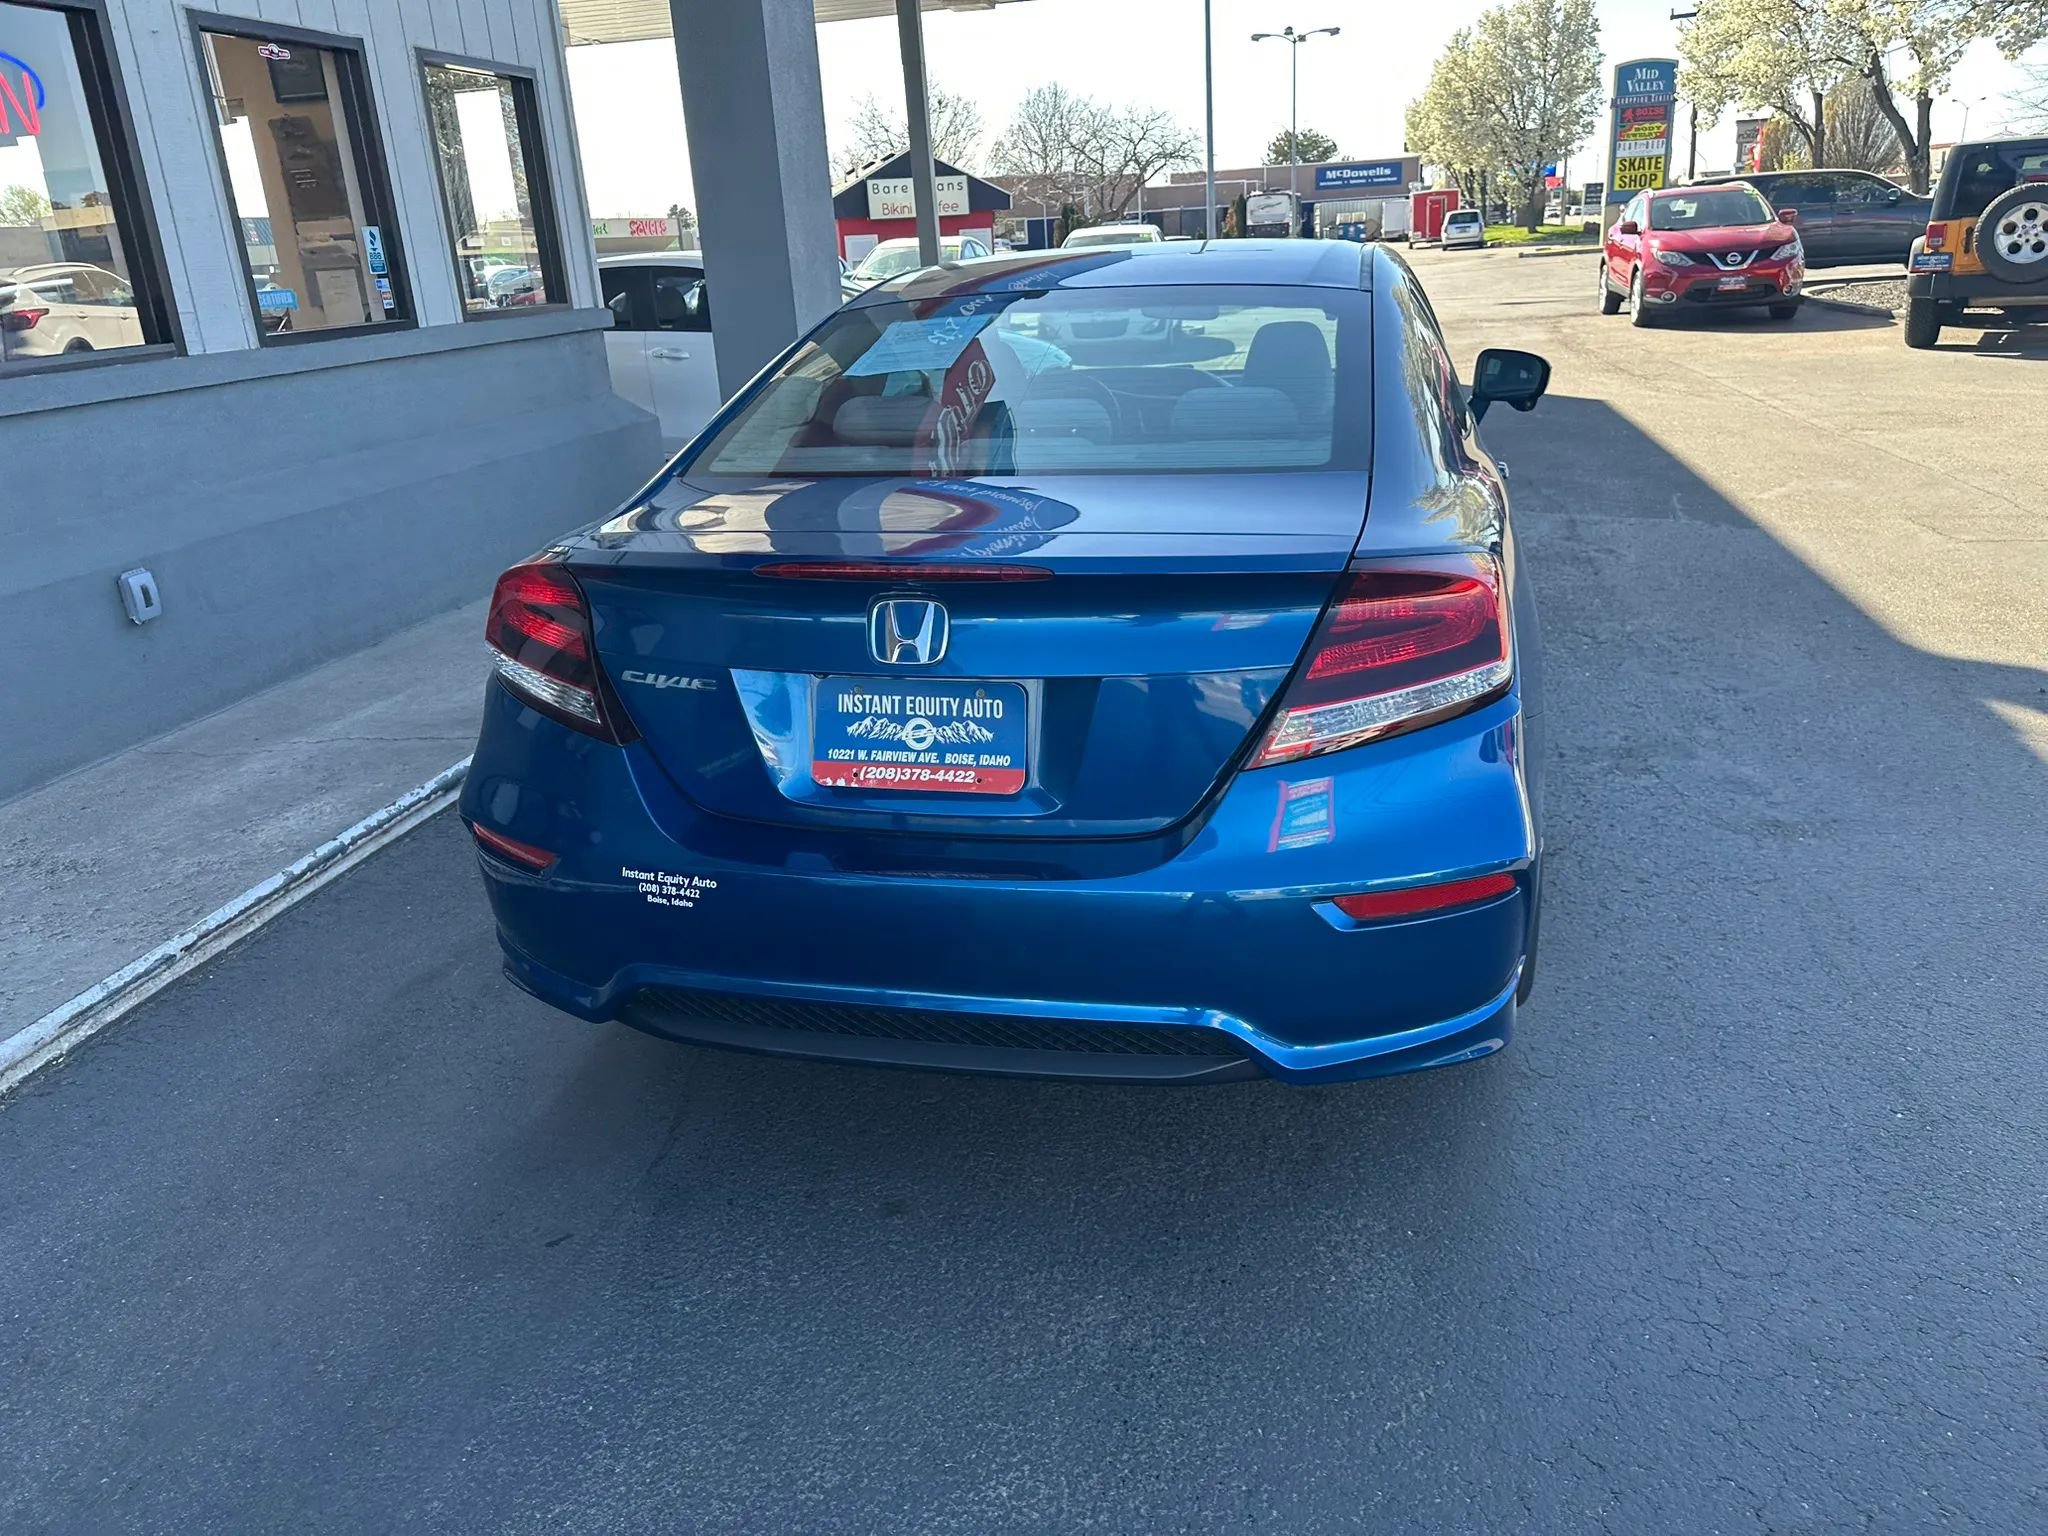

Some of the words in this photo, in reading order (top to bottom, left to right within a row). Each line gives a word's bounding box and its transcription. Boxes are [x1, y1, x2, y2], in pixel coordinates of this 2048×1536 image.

[1618, 156, 1663, 172] SKATE
[1325, 166, 1392, 179] McDowells
[871, 182, 909, 195] Bare
[1618, 173, 1658, 189] SHOP
[882, 201, 913, 216] Bikini
[838, 693, 901, 715] INSTANT
[906, 695, 960, 718] EQUITY
[963, 698, 1004, 719] AUTO
[827, 748, 855, 760] 10221
[857, 750, 869, 760] W.
[870, 750, 917, 763] FAIRVIEW
[918, 752, 940, 764] AVE.
[944, 754, 977, 767] BOISE,
[979, 755, 1011, 766] IDAHO
[859, 766, 976, 783] (208)378-4422
[621, 866, 655, 881] Instant
[657, 872, 690, 888] Equity
[691, 876, 718, 889] Auto
[638, 882, 660, 895] (208)
[661, 885, 700, 898] 378-4422
[646, 894, 670, 906] Boise,
[671, 897, 694, 908] Idaho
